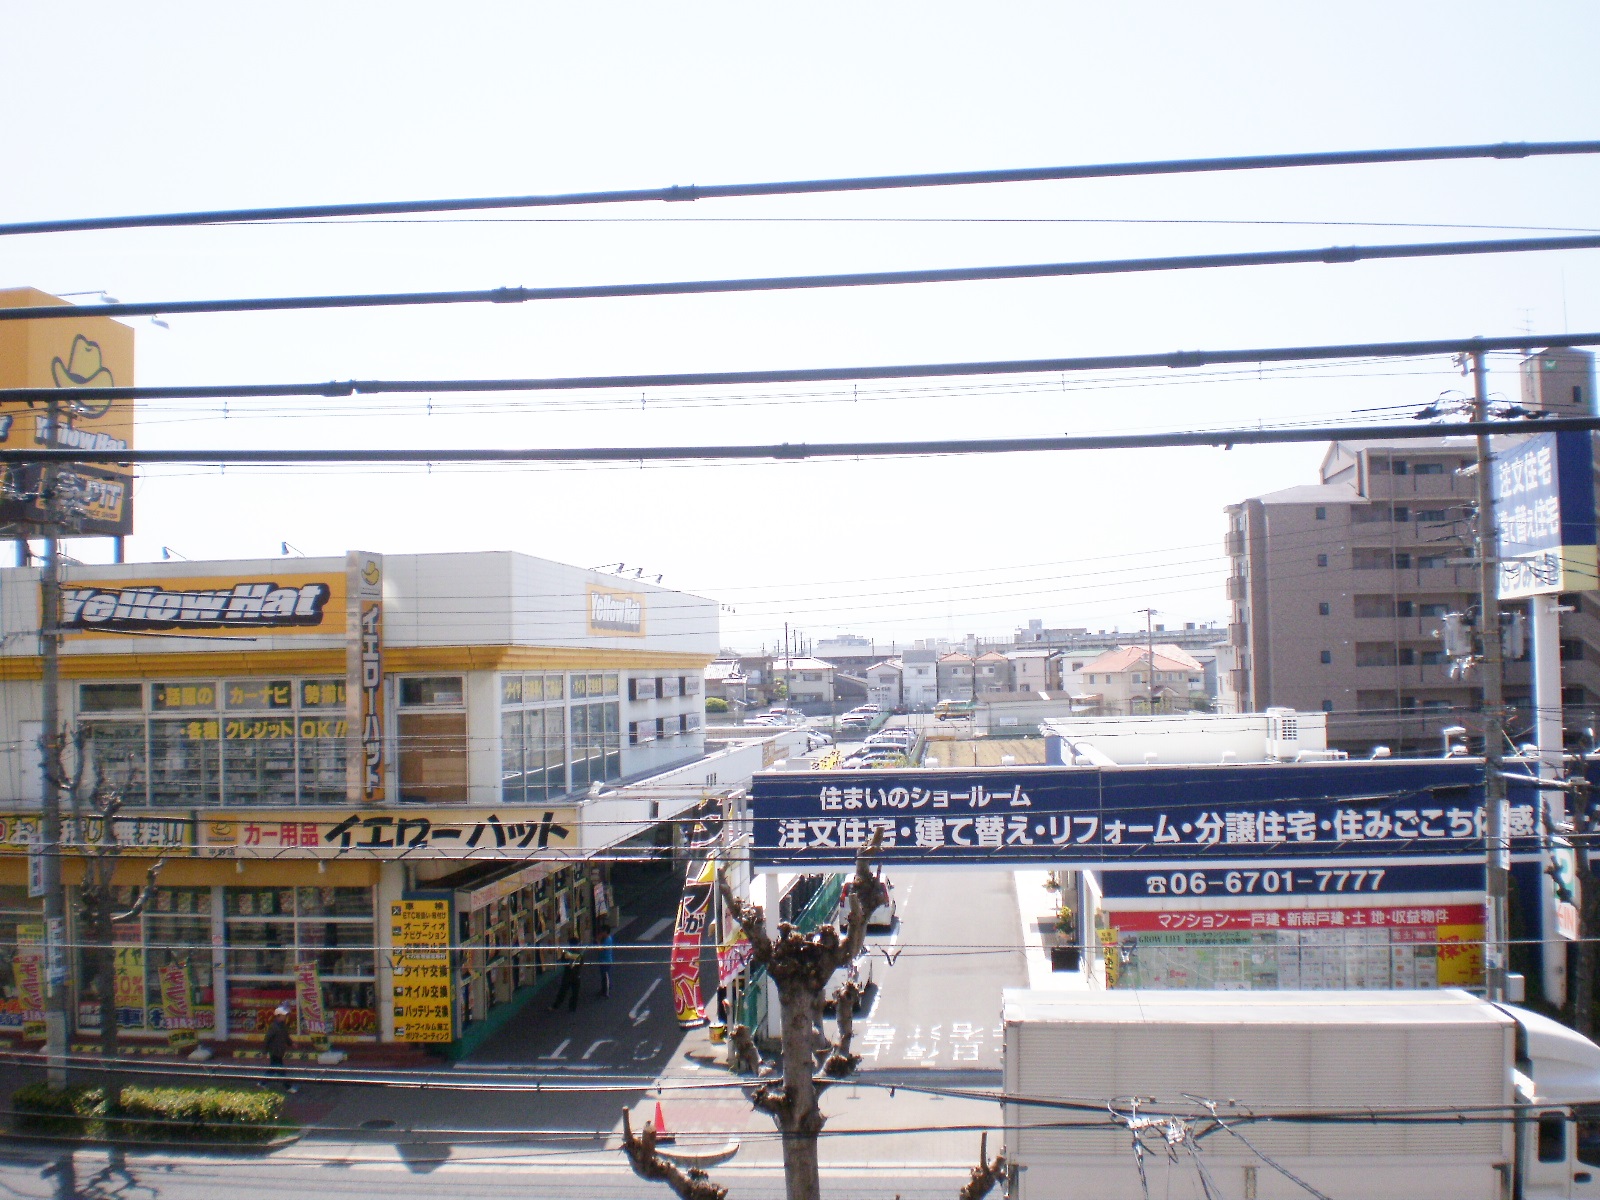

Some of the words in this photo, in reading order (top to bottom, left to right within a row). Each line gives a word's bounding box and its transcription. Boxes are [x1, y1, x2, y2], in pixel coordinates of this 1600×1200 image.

[226, 721, 292, 739] クレジット
[820, 786, 1032, 811] 住まいのショールーム
[245, 822, 319, 847] カー用品
[324, 812, 569, 852] イエローハット
[404, 965, 448, 978] タイヤ交換
[405, 985, 448, 998] オイル交換
